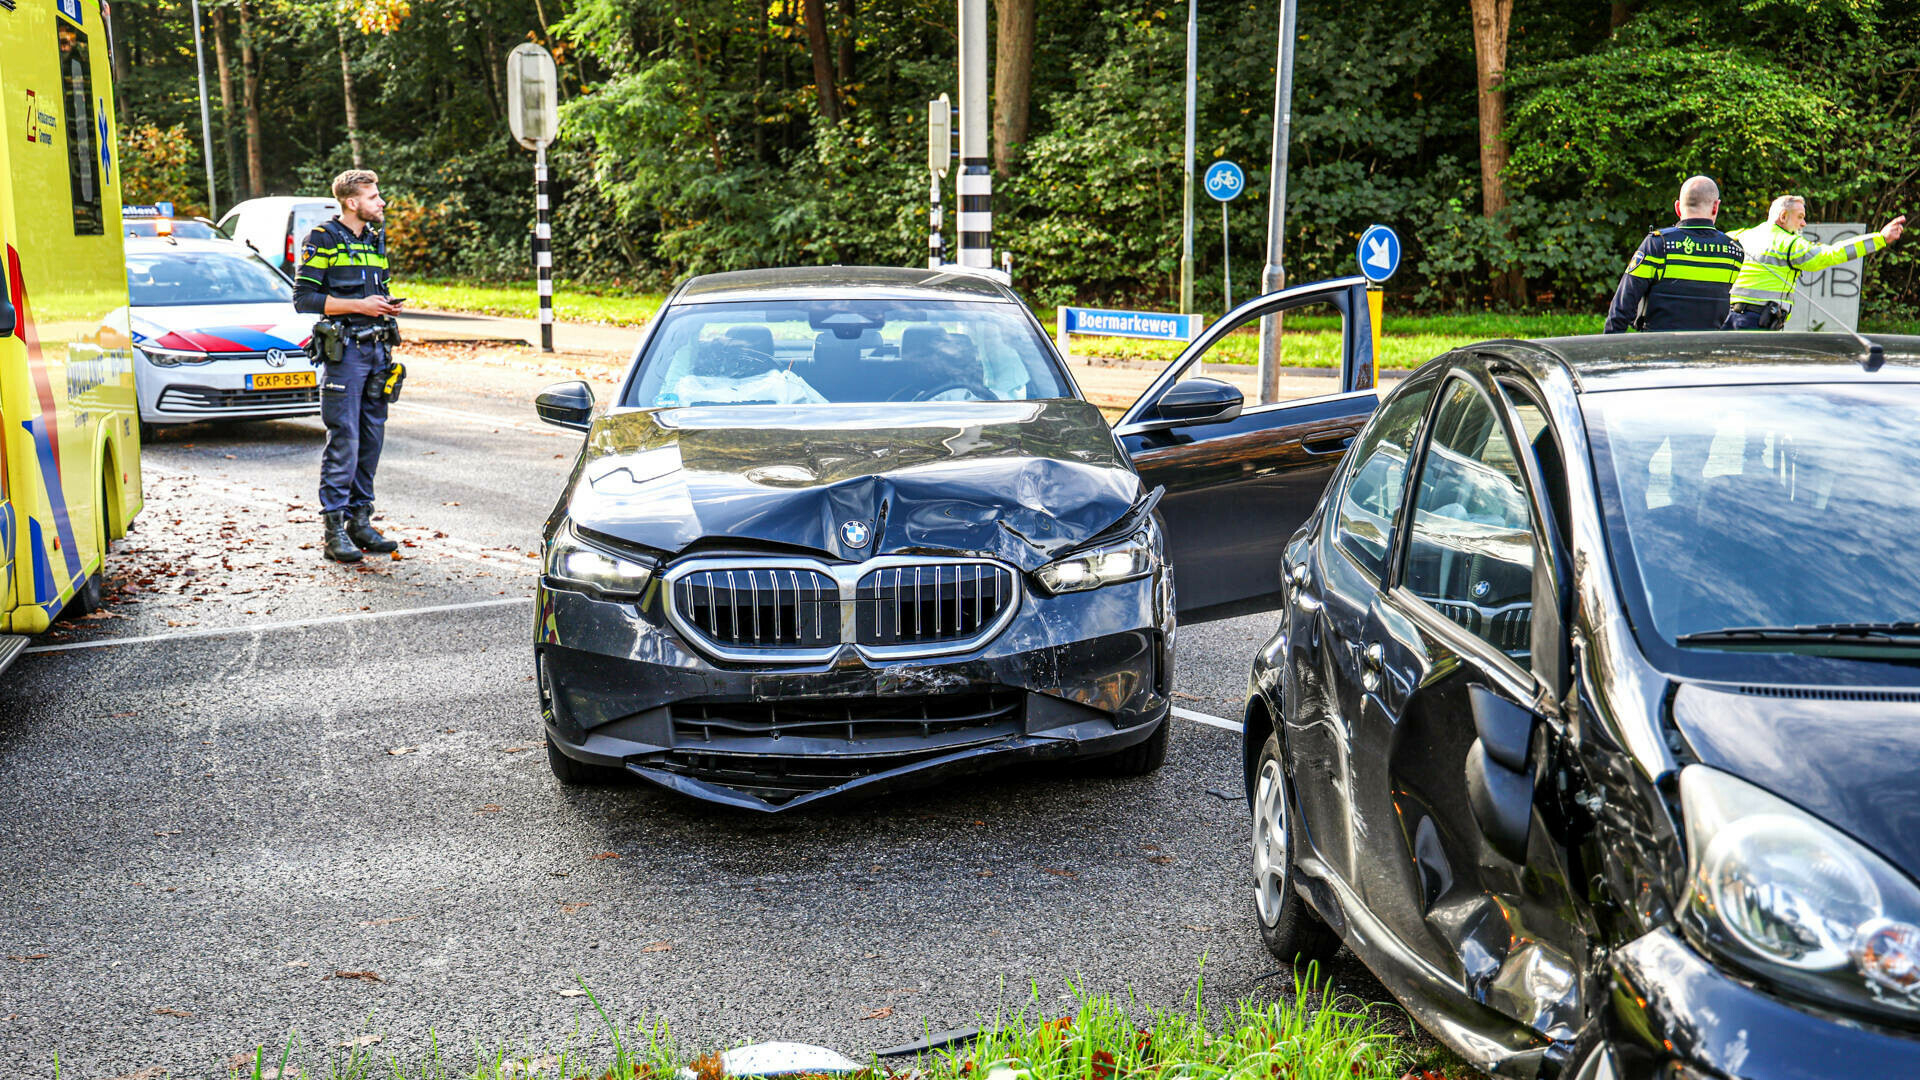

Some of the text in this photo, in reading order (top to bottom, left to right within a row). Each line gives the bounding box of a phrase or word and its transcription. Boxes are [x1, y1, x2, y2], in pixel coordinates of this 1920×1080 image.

[122, 205, 159, 215] ellent
[1675, 236, 1729, 255] POLITIE
[1078, 311, 1177, 338] Boermarkeweg
[256, 373, 312, 387] GXP-85-K
